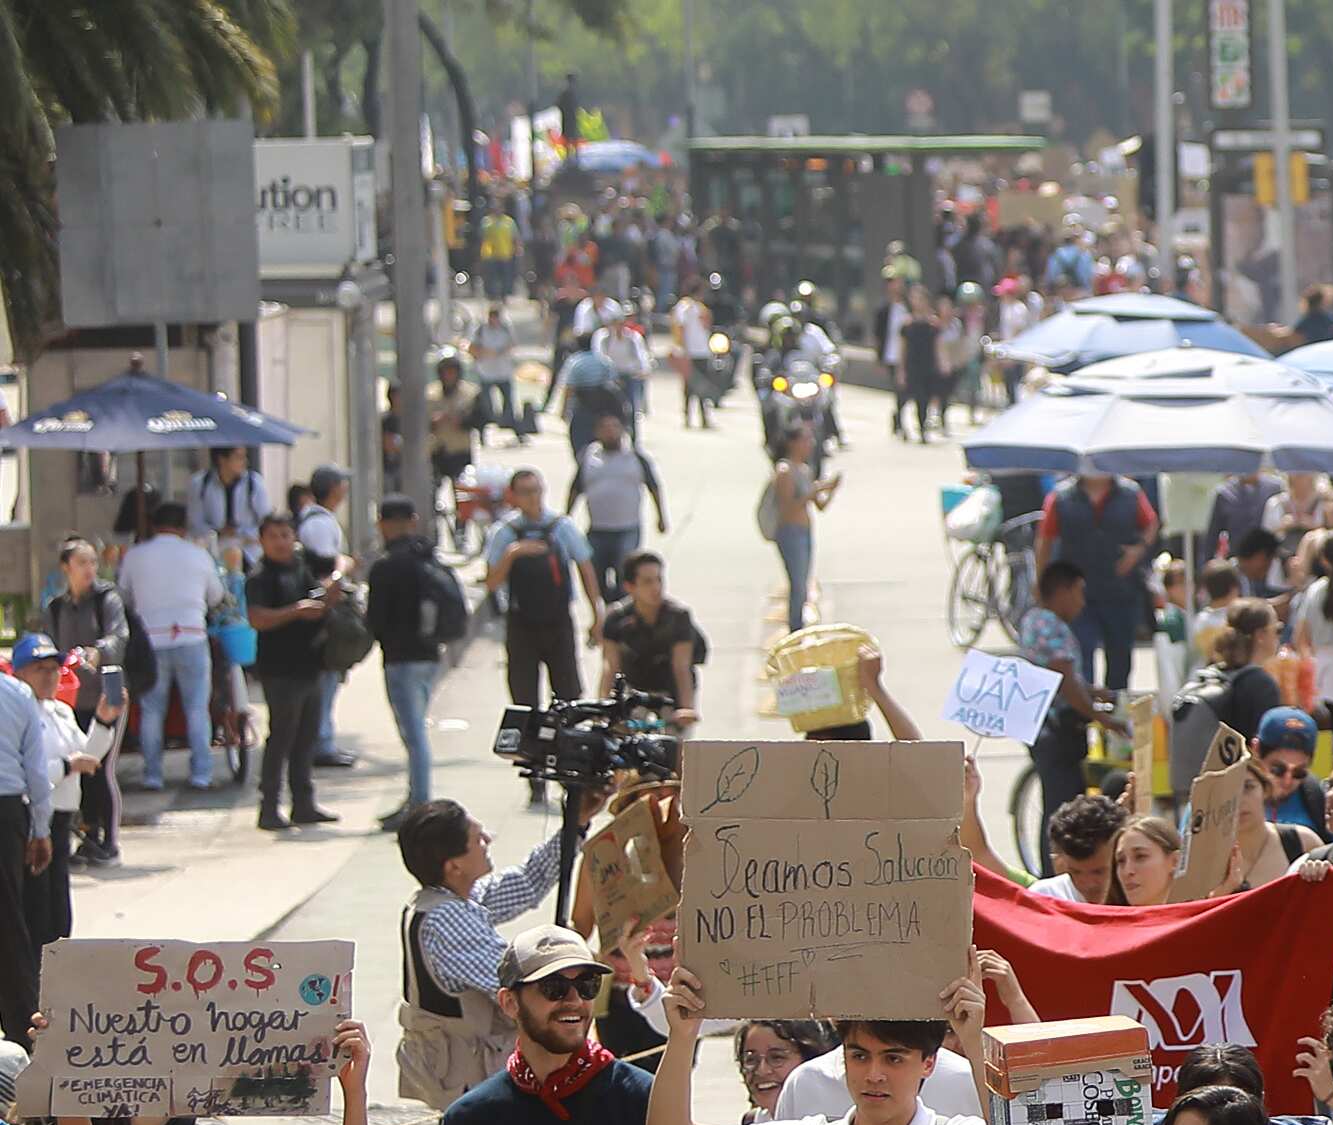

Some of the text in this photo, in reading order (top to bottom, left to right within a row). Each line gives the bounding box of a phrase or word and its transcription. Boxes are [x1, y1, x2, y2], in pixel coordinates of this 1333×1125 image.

[955, 667, 1050, 724] UAM
[695, 900, 922, 944] NO EL PROBLEMA
[134, 946, 277, 998] S.O.S
[68, 999, 310, 1044] Nuestro hogar
[65, 1034, 153, 1068] está
[171, 1041, 208, 1064] en
